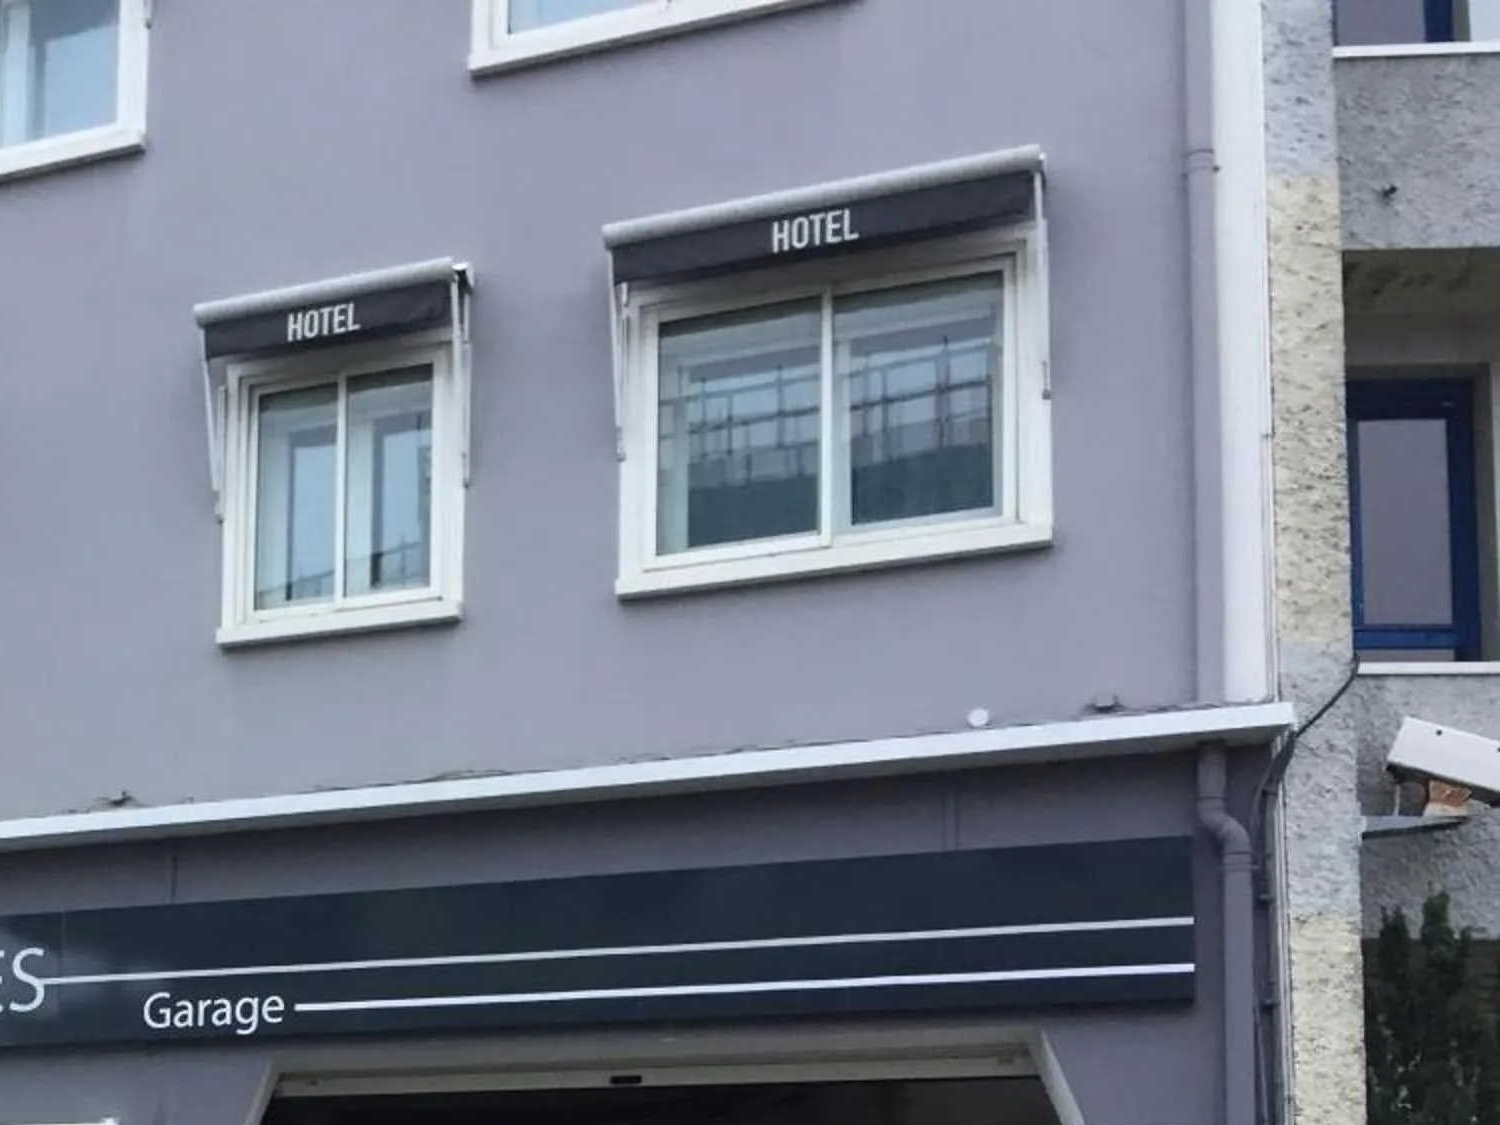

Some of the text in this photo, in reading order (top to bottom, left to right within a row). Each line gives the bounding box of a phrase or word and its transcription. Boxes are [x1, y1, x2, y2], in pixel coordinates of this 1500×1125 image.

[771, 208, 860, 254] HOTEL
[286, 301, 361, 342] HOTEL
[142, 988, 287, 1037] Garage
